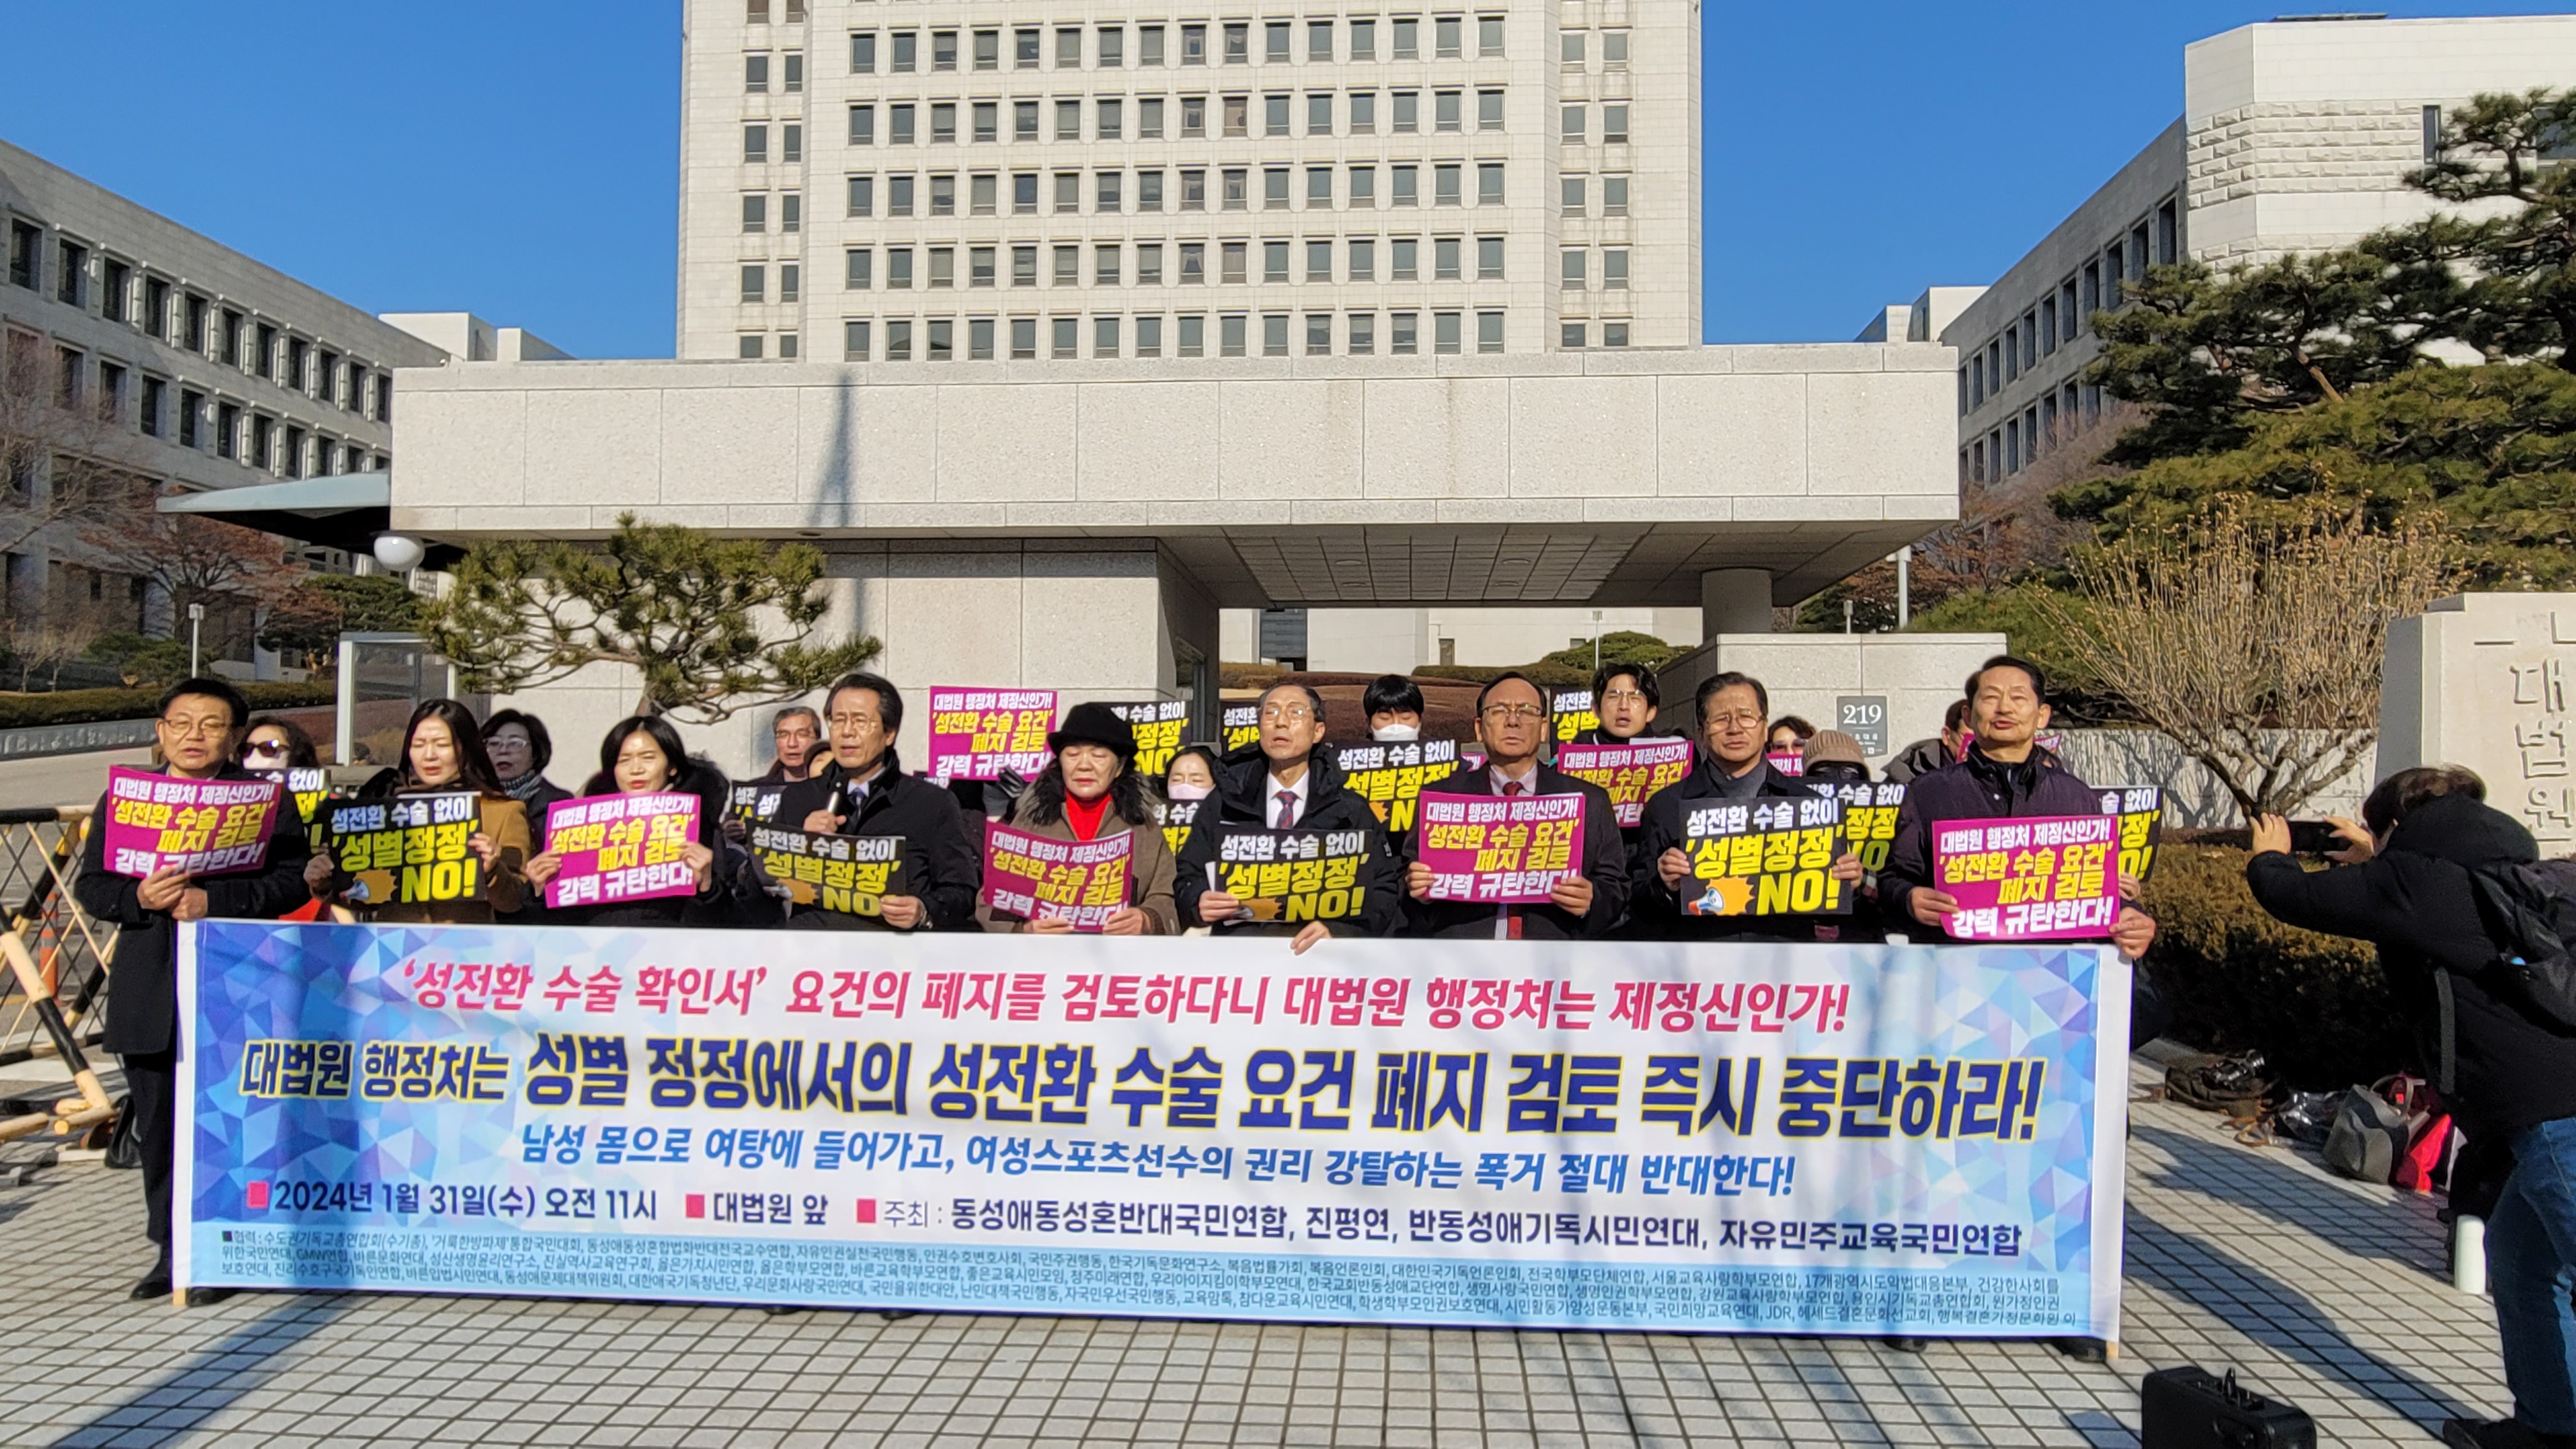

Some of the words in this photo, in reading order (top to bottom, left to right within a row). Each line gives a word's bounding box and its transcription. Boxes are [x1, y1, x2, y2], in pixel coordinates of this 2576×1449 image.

[982, 710, 1014, 733] 수술
[1843, 704, 1882, 724] 219
[971, 733, 1008, 753] 폐지
[1010, 732, 1046, 752] 검토
[114, 777, 151, 801] 대법원
[154, 782, 197, 804] 행정처
[175, 806, 220, 831] 수술
[331, 804, 386, 834] 성전환
[391, 800, 429, 827] 수술
[433, 795, 473, 823] 없이
[1426, 802, 1465, 822] 대법원
[1468, 802, 1507, 822] 행정처
[1509, 797, 1579, 822] 제정신인가!
[1687, 806, 1749, 837] 성전환
[1753, 801, 1794, 831] 수술
[1800, 797, 1839, 827] 없이
[156, 829, 211, 853] 폐지
[213, 826, 263, 849] 검토
[332, 819, 479, 872] '성별정정'
[752, 826, 808, 854] 성전환
[811, 836, 850, 860] 수술
[856, 838, 897, 861] 없이
[1220, 834, 1276, 861] 성전환
[1280, 834, 1319, 859] 수술
[1325, 831, 1365, 856] 없이
[1424, 823, 1486, 849] '성전환
[1489, 823, 1529, 848] 수술
[1532, 818, 1580, 847] 요건'
[1940, 829, 1983, 853] 대법원
[1987, 824, 2030, 850] 행정처
[2033, 818, 2111, 846] 제정신인가!
[753, 846, 901, 894] '성별정정'
[1474, 848, 1521, 871] 폐지
[1525, 845, 1571, 870] 검토
[1685, 824, 1844, 880] '성별정정'
[1940, 851, 2009, 884] '성전환
[2014, 847, 2056, 878] 수술
[2060, 841, 2113, 872] 요건'
[401, 857, 477, 903] NO!
[1219, 854, 1370, 900] '성별정정'
[1429, 873, 1475, 899] 강력
[1757, 868, 1841, 916] NO!
[1998, 875, 2048, 904] 폐지
[2055, 870, 2104, 900] 검토
[1285, 886, 1366, 923] NO!
[1952, 907, 1998, 938] 강력
[2005, 896, 2114, 935] 규탄한다!
[543, 967, 622, 1013] 수술
[786, 969, 912, 1019] 요건의
[921, 971, 1047, 1022] 폐지를
[1060, 972, 1269, 1024] 검토하다니
[1283, 975, 1411, 1028] 대법원
[1426, 977, 1598, 1030] 행정처는
[1610, 981, 1850, 1035] 제정신인가!
[240, 1040, 352, 1098] 대법원
[361, 1041, 512, 1102] 행정처는
[525, 1032, 629, 1109] 성별
[644, 1036, 912, 1117] 정정에서의
[927, 1040, 1098, 1125] 성전환
[1110, 1046, 1225, 1130] 수술
[1238, 1048, 1357, 1131] 요건
[1370, 1051, 1490, 1133] 폐지
[1505, 1053, 1625, 1136] 검토
[1641, 1055, 1763, 1136] 즉시
[1776, 1059, 2047, 1142] 중단하라!
[521, 1124, 588, 1165] 남성
[595, 1126, 691, 1165] 몸으로
[704, 1127, 803, 1169] 여탕에
[814, 1131, 955, 1174] 들어가고,
[966, 1133, 1232, 1180] 여성스포츠선수의
[1244, 1147, 1310, 1183] 권리
[1324, 1149, 1462, 1190] 강탈하는
[1475, 1154, 1545, 1190] 폭거
[1558, 1154, 1626, 1194] 절대
[1639, 1155, 1795, 1197] 반대한다!
[273, 1181, 373, 1215] 2024년
[382, 1181, 420, 1215] 1월
[429, 1184, 537, 1220] 31일(수)
[544, 1188, 597, 1219] 오전
[606, 1188, 658, 1221] 11시
[713, 1190, 792, 1223] 대법원
[802, 1194, 829, 1226] 앞
[234, 1230, 255, 1246] 협력
[884, 1199, 930, 1229] 주최
[951, 1199, 1296, 1242] 동성애동성혼반대국민연합,
[1306, 1206, 1399, 1243] 진평연,
[1409, 1209, 1710, 1251] 반동성애기독시민연대,
[1719, 1220, 2022, 1257] 자유민주교육국민연합
[1765, 1304, 1795, 1321] JDR,
